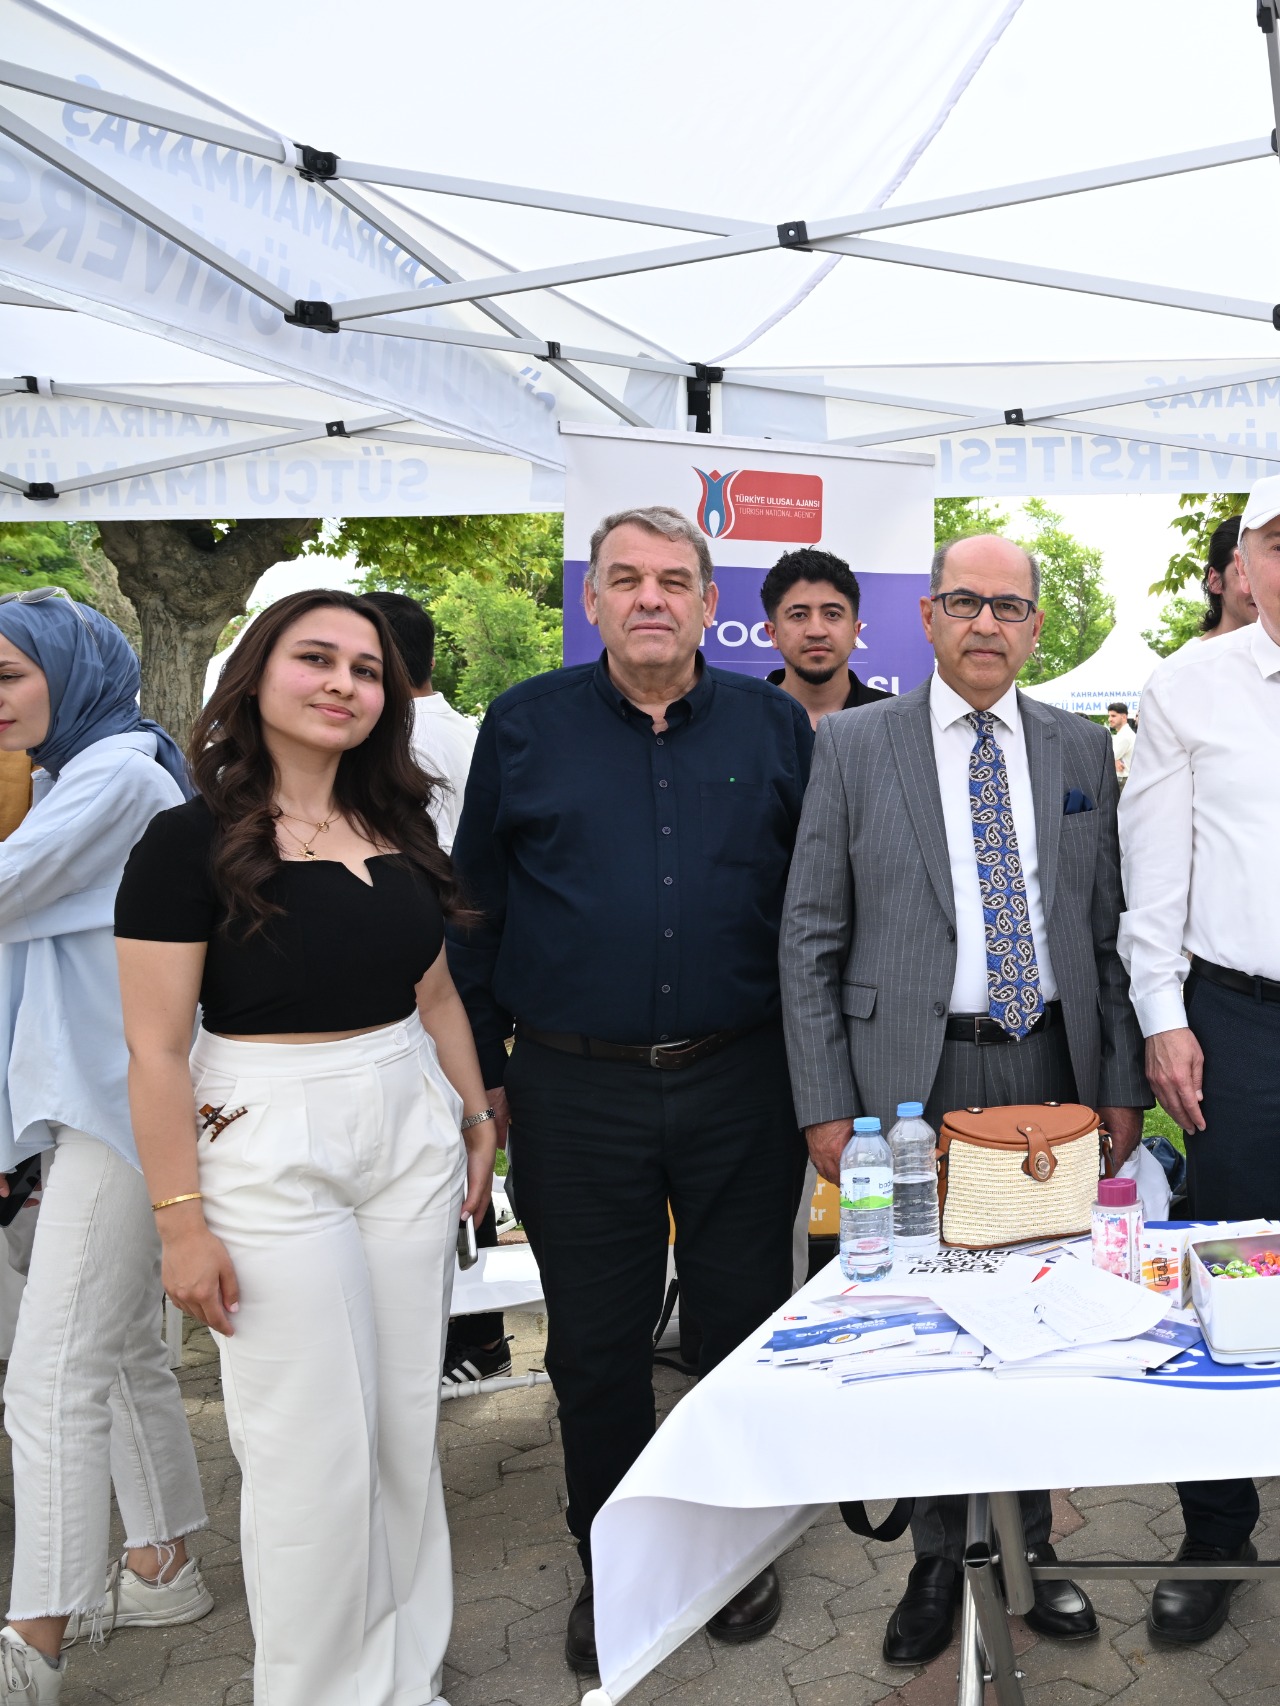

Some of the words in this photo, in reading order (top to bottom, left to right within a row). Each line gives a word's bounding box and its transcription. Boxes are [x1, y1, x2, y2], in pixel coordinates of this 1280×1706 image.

[735, 493, 766, 505] TÜRKİYE
[766, 497, 794, 506] ULUSAL
[796, 499, 820, 508] AJANSI
[739, 507, 764, 516] TURKISH
[765, 508, 792, 518] NATIONAL
[794, 510, 816, 519] AGENCY
